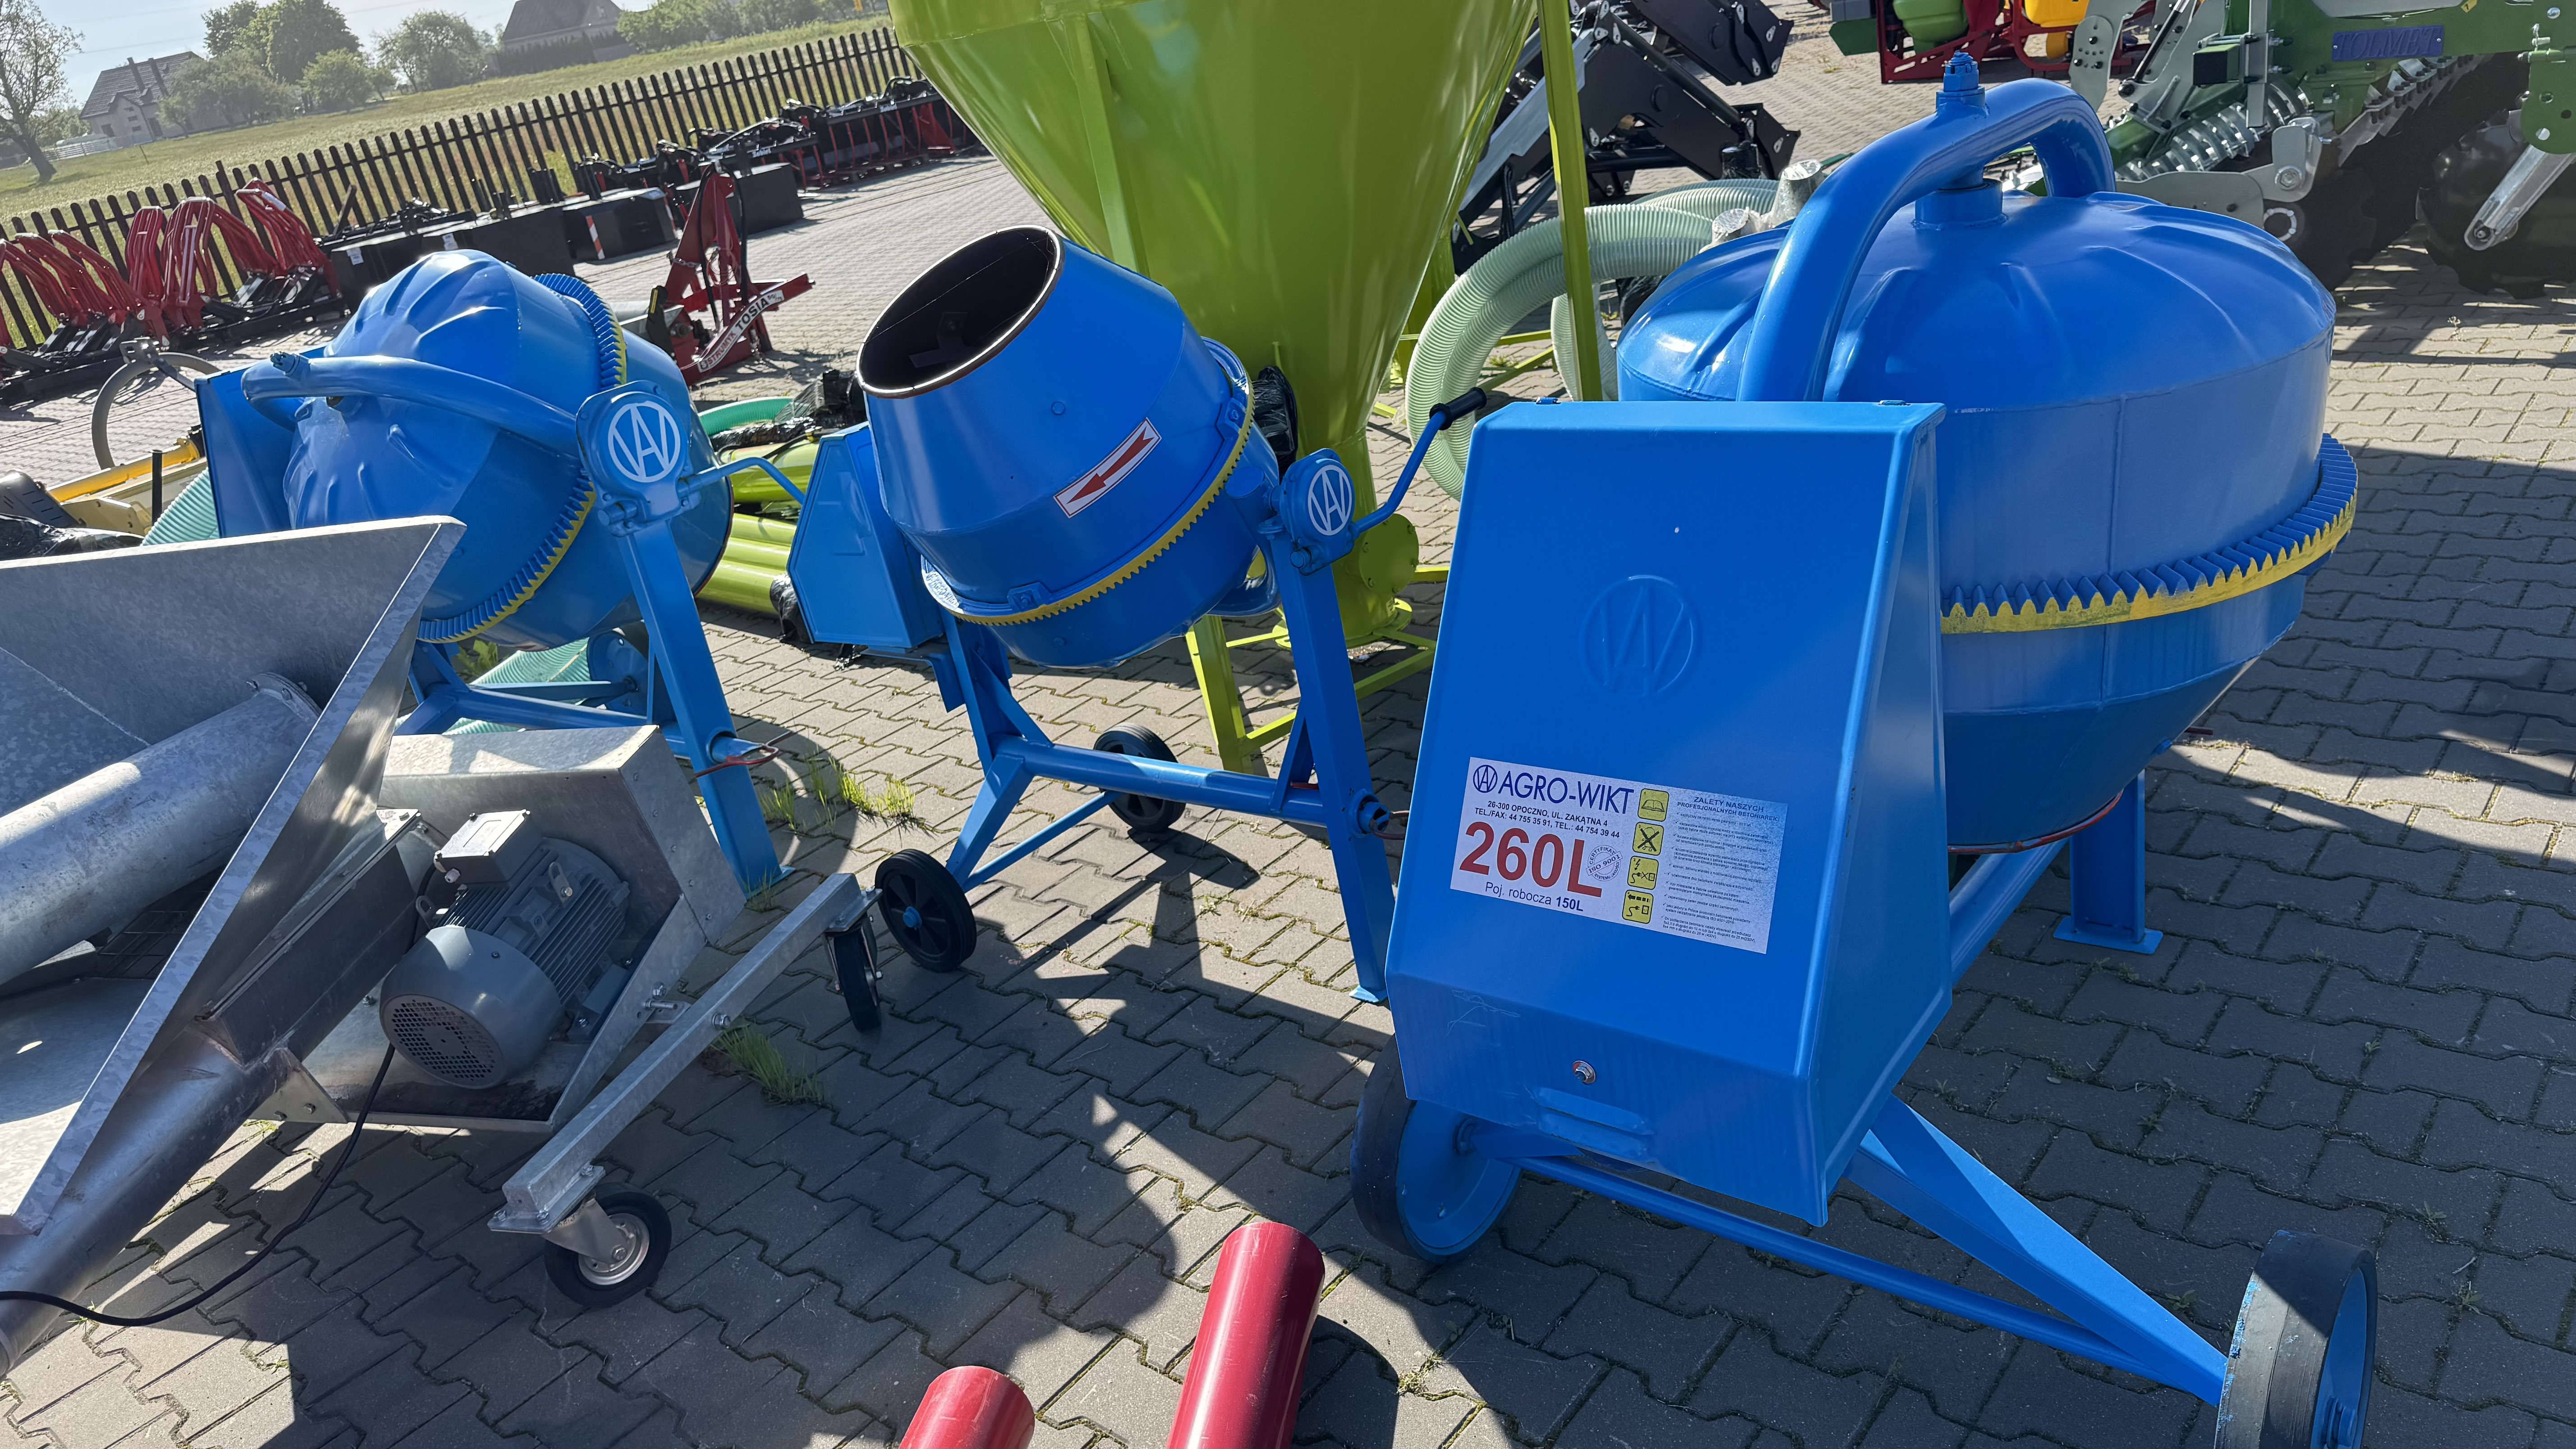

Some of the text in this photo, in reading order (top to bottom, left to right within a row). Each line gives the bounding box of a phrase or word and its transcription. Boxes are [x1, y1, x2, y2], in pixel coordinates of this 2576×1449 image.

[2336, 28, 2441, 58] TOLMET
[735, 298, 768, 331] TOSIA
[1498, 770, 1634, 814] AGRO-WIKT
[1694, 796, 1765, 812] ZALETY NASZYCH
[1475, 807, 1507, 819] TEL./FAX:
[1519, 815, 1531, 823] 755
[1543, 819, 1553, 828] 91,
[1555, 821, 1573, 831] TEL.:
[1586, 827, 1598, 835] 754
[1487, 800, 1509, 810] 26-300
[1511, 804, 1549, 818] OPOCZNO,
[1551, 811, 1563, 820] UL.
[1564, 813, 1601, 826] ZAKĄTNA
[1677, 802, 1737, 815] PROFESJONALNYCH
[1459, 821, 1602, 898] 260L
[1588, 855, 1620, 873] ISO 9001
[1485, 882, 1583, 912] Poj. robocza 150L
